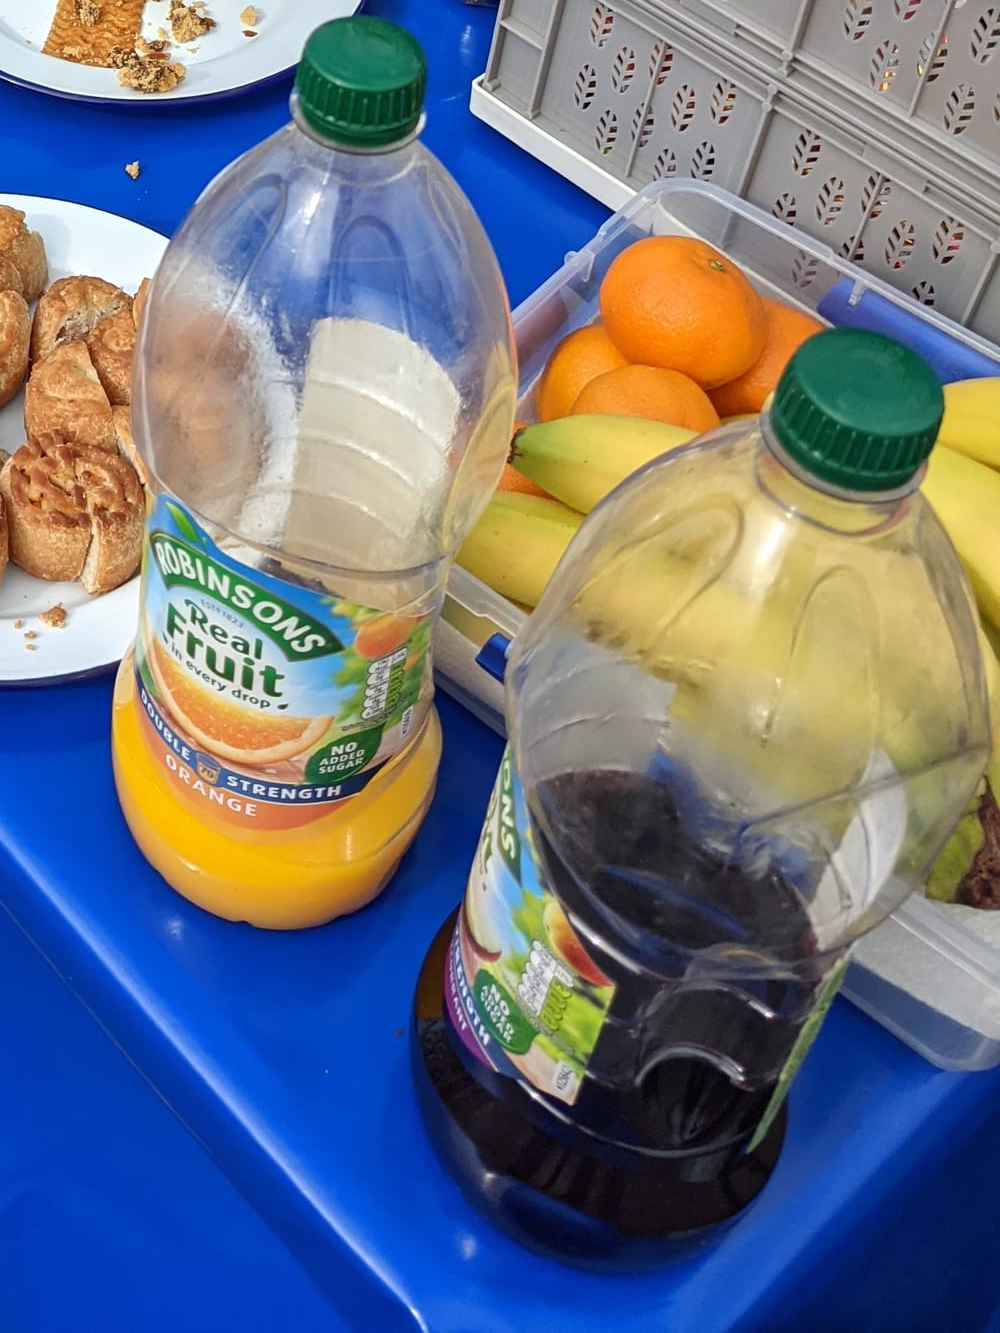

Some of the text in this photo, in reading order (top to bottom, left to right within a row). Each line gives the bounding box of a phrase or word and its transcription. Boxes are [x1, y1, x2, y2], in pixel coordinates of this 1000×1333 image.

[154, 541, 327, 654] ROBINSONS
[183, 598, 263, 660] Real
[166, 601, 286, 698] Fruit
[171, 641, 272, 711] in every drop
[141, 688, 192, 762] DOUBLE
[226, 774, 343, 800] STRENGTH
[318, 757, 365, 775] SUGAR
[319, 748, 366, 767] ADDED
[331, 741, 359, 757] NO
[165, 752, 258, 817] ORANGE
